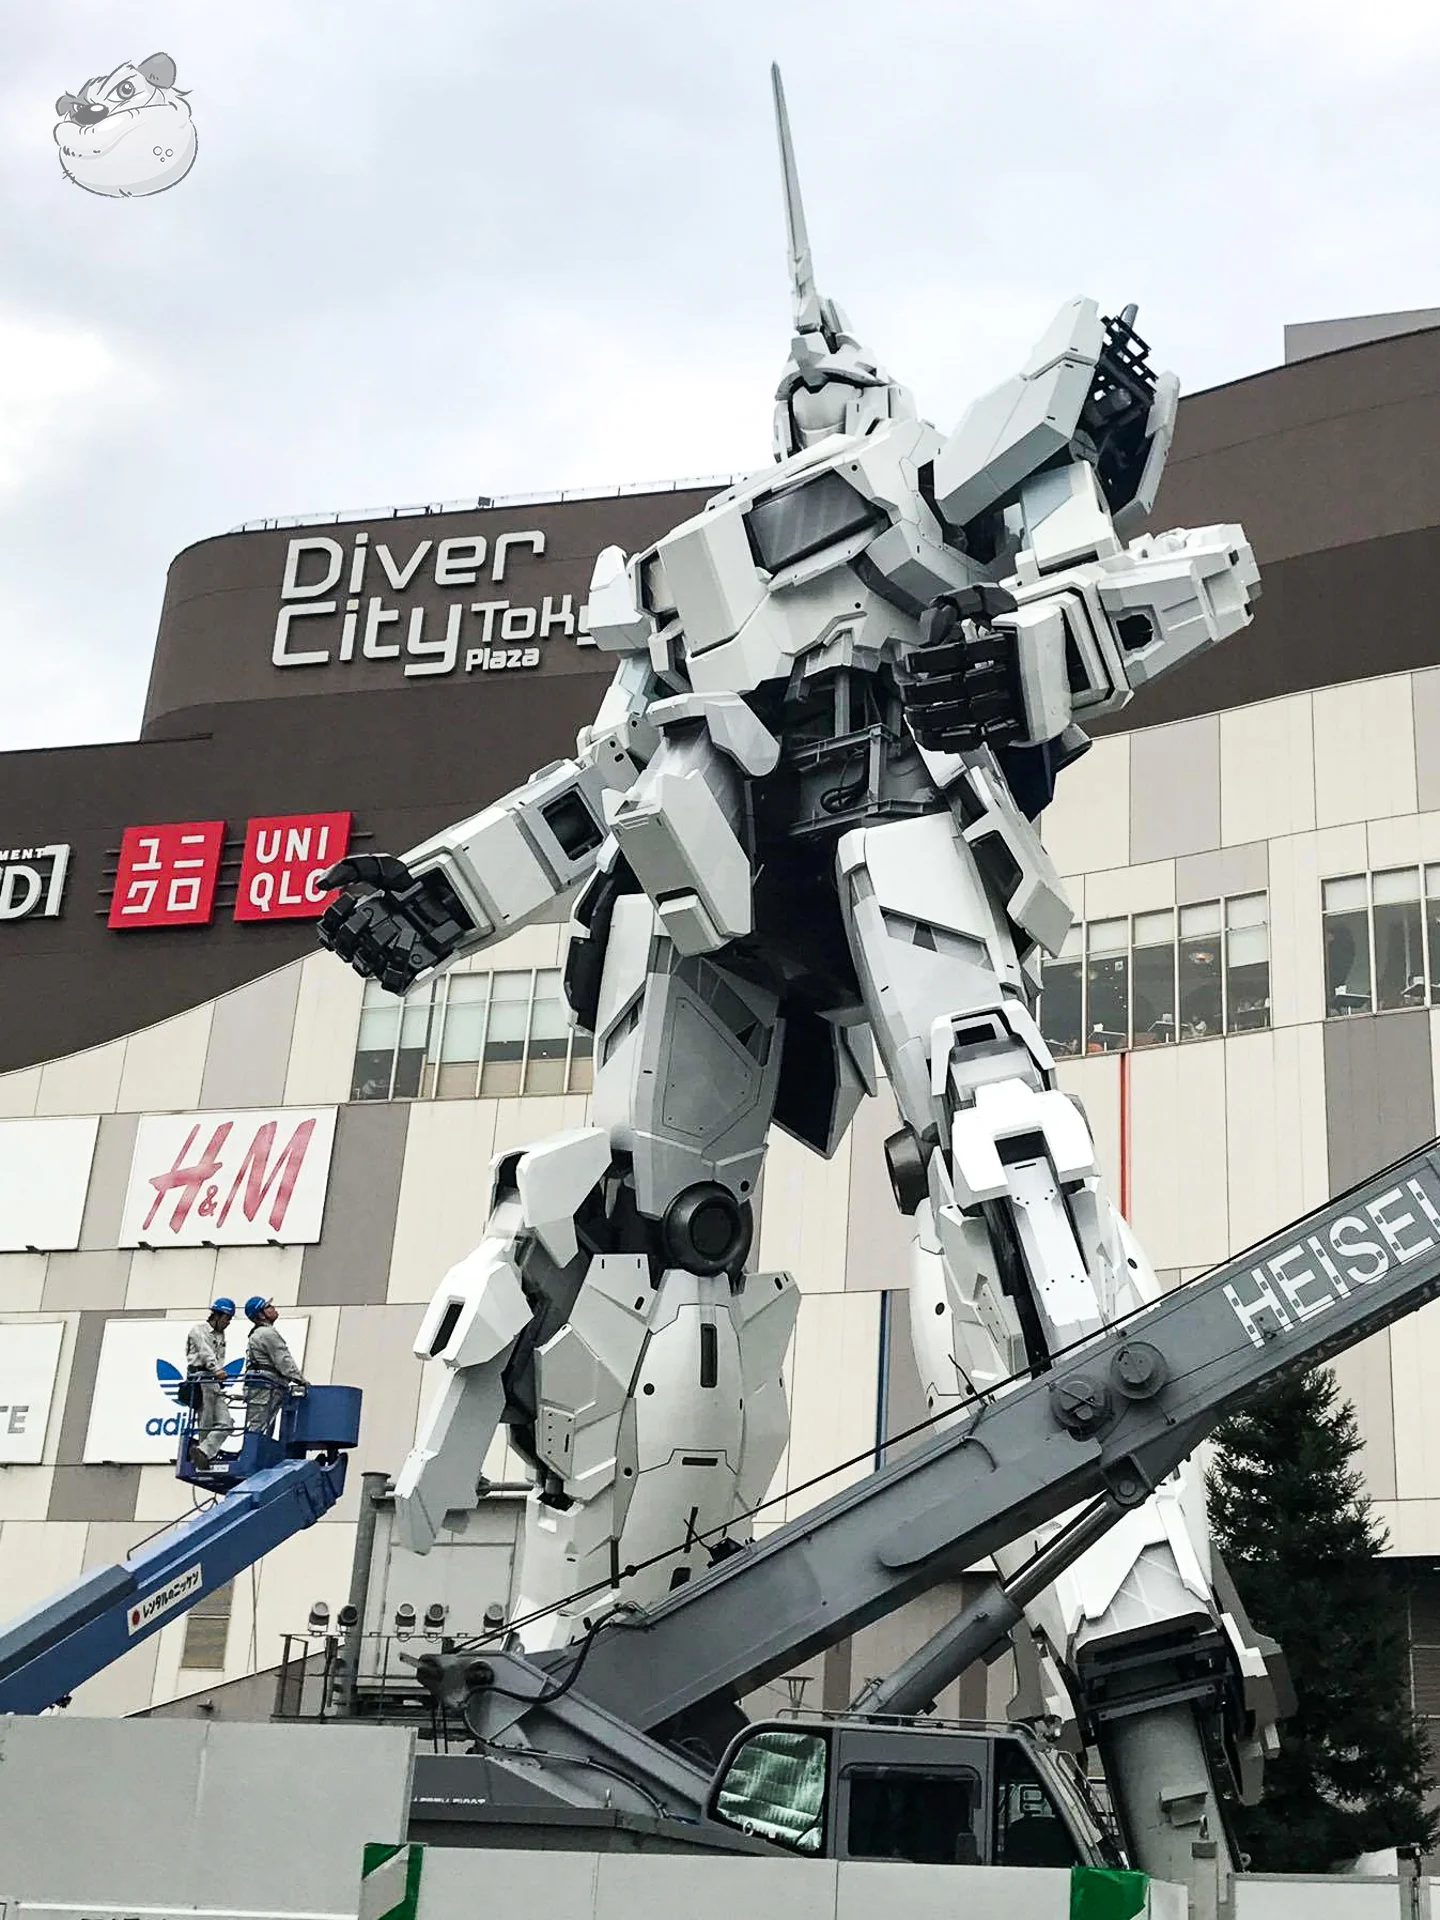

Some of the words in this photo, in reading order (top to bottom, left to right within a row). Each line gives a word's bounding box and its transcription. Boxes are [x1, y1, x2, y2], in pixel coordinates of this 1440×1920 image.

[281, 530, 546, 599] Diver
[272, 596, 462, 677] City
[465, 647, 540, 671] Plaza
[131, 834, 205, 872] ユニ
[255, 826, 330, 864] UNI
[0, 844, 70, 919] D1
[121, 877, 201, 914] クロ
[142, 1118, 316, 1234] H&M
[1222, 1178, 1440, 1349] HEISEI
